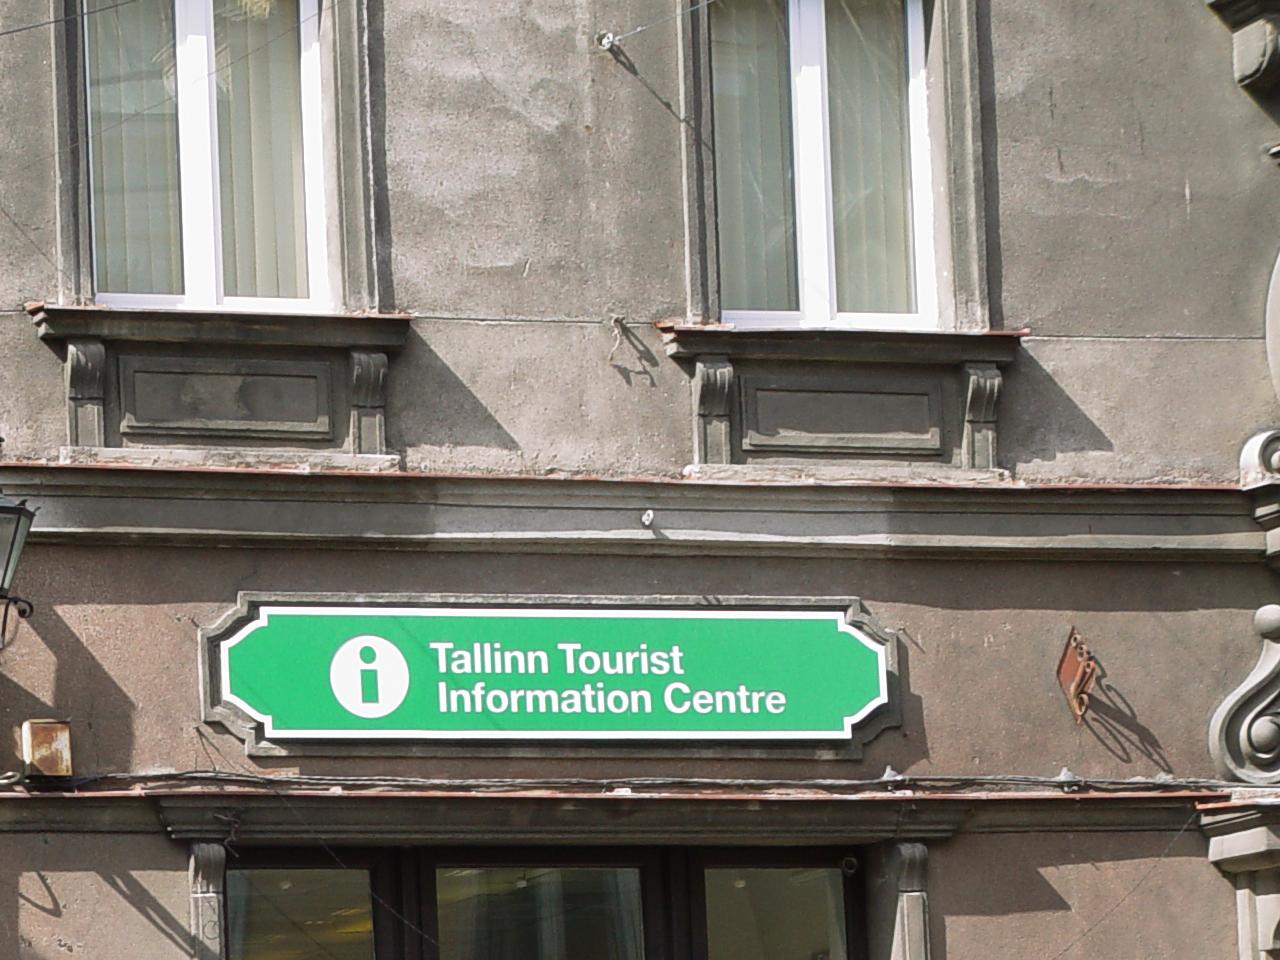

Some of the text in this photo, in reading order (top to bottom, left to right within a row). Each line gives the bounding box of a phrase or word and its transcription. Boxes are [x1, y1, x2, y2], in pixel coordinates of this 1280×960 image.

[430, 641, 684, 676] Tallinn Tourist
[437, 681, 786, 715] Information Centre
